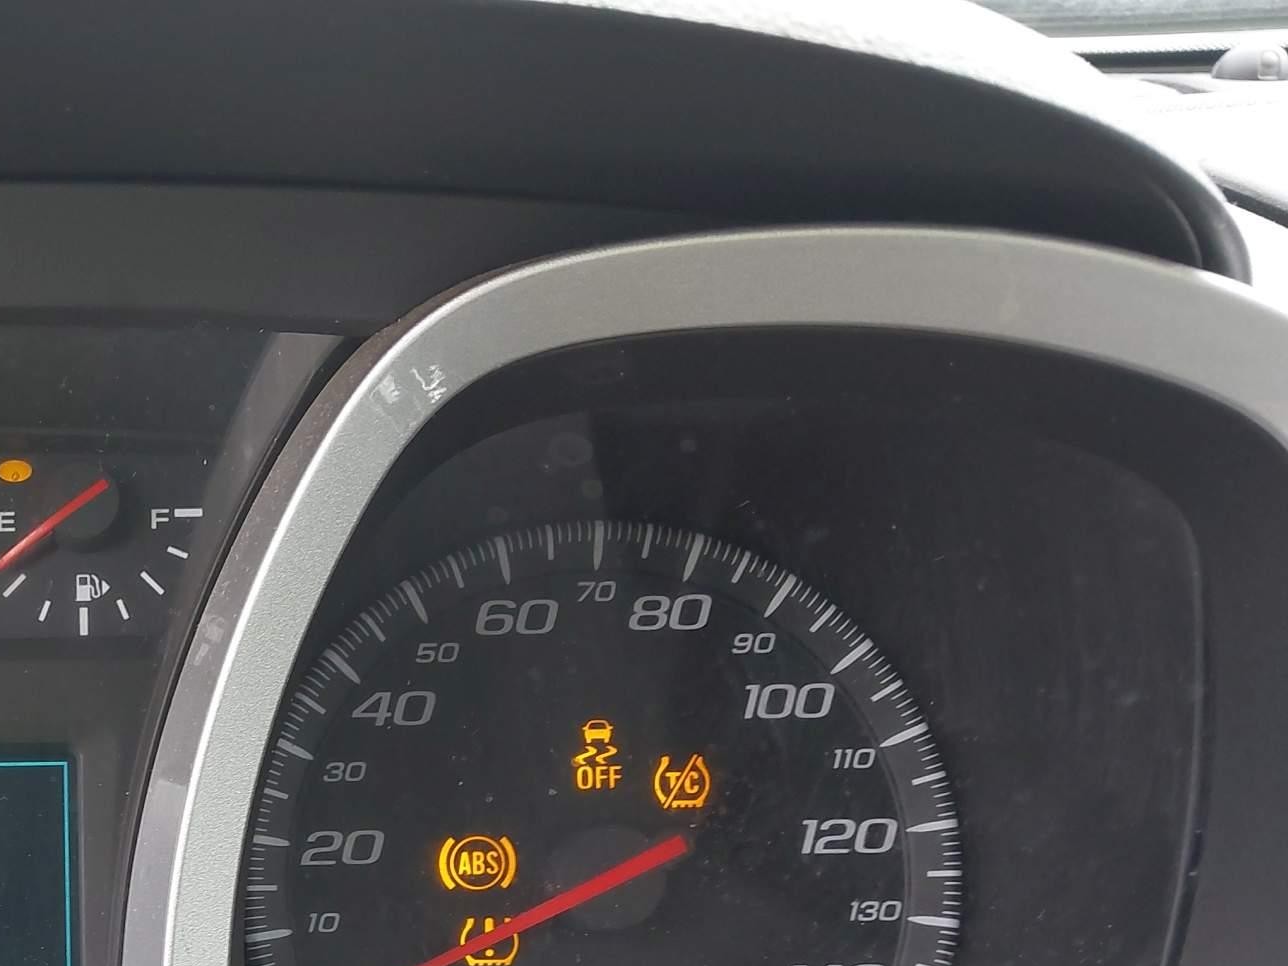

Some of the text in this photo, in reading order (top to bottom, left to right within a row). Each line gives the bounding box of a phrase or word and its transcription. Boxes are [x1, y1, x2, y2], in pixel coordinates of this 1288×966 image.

[151, 509, 170, 529] F
[576, 581, 615, 601] 70
[475, 601, 558, 635] 60
[629, 594, 711, 631] 80
[415, 642, 460, 664] 50
[732, 633, 775, 654] 90
[351, 691, 435, 726] 40
[743, 683, 834, 719] 100
[832, 749, 875, 769] 110
[323, 761, 366, 783] 30
[576, 767, 621, 789] OFF
[801, 818, 898, 853] 120
[301, 831, 383, 865] 20
[458, 851, 500, 876] ABS
[307, 913, 340, 933] 10
[849, 902, 901, 923] 130
